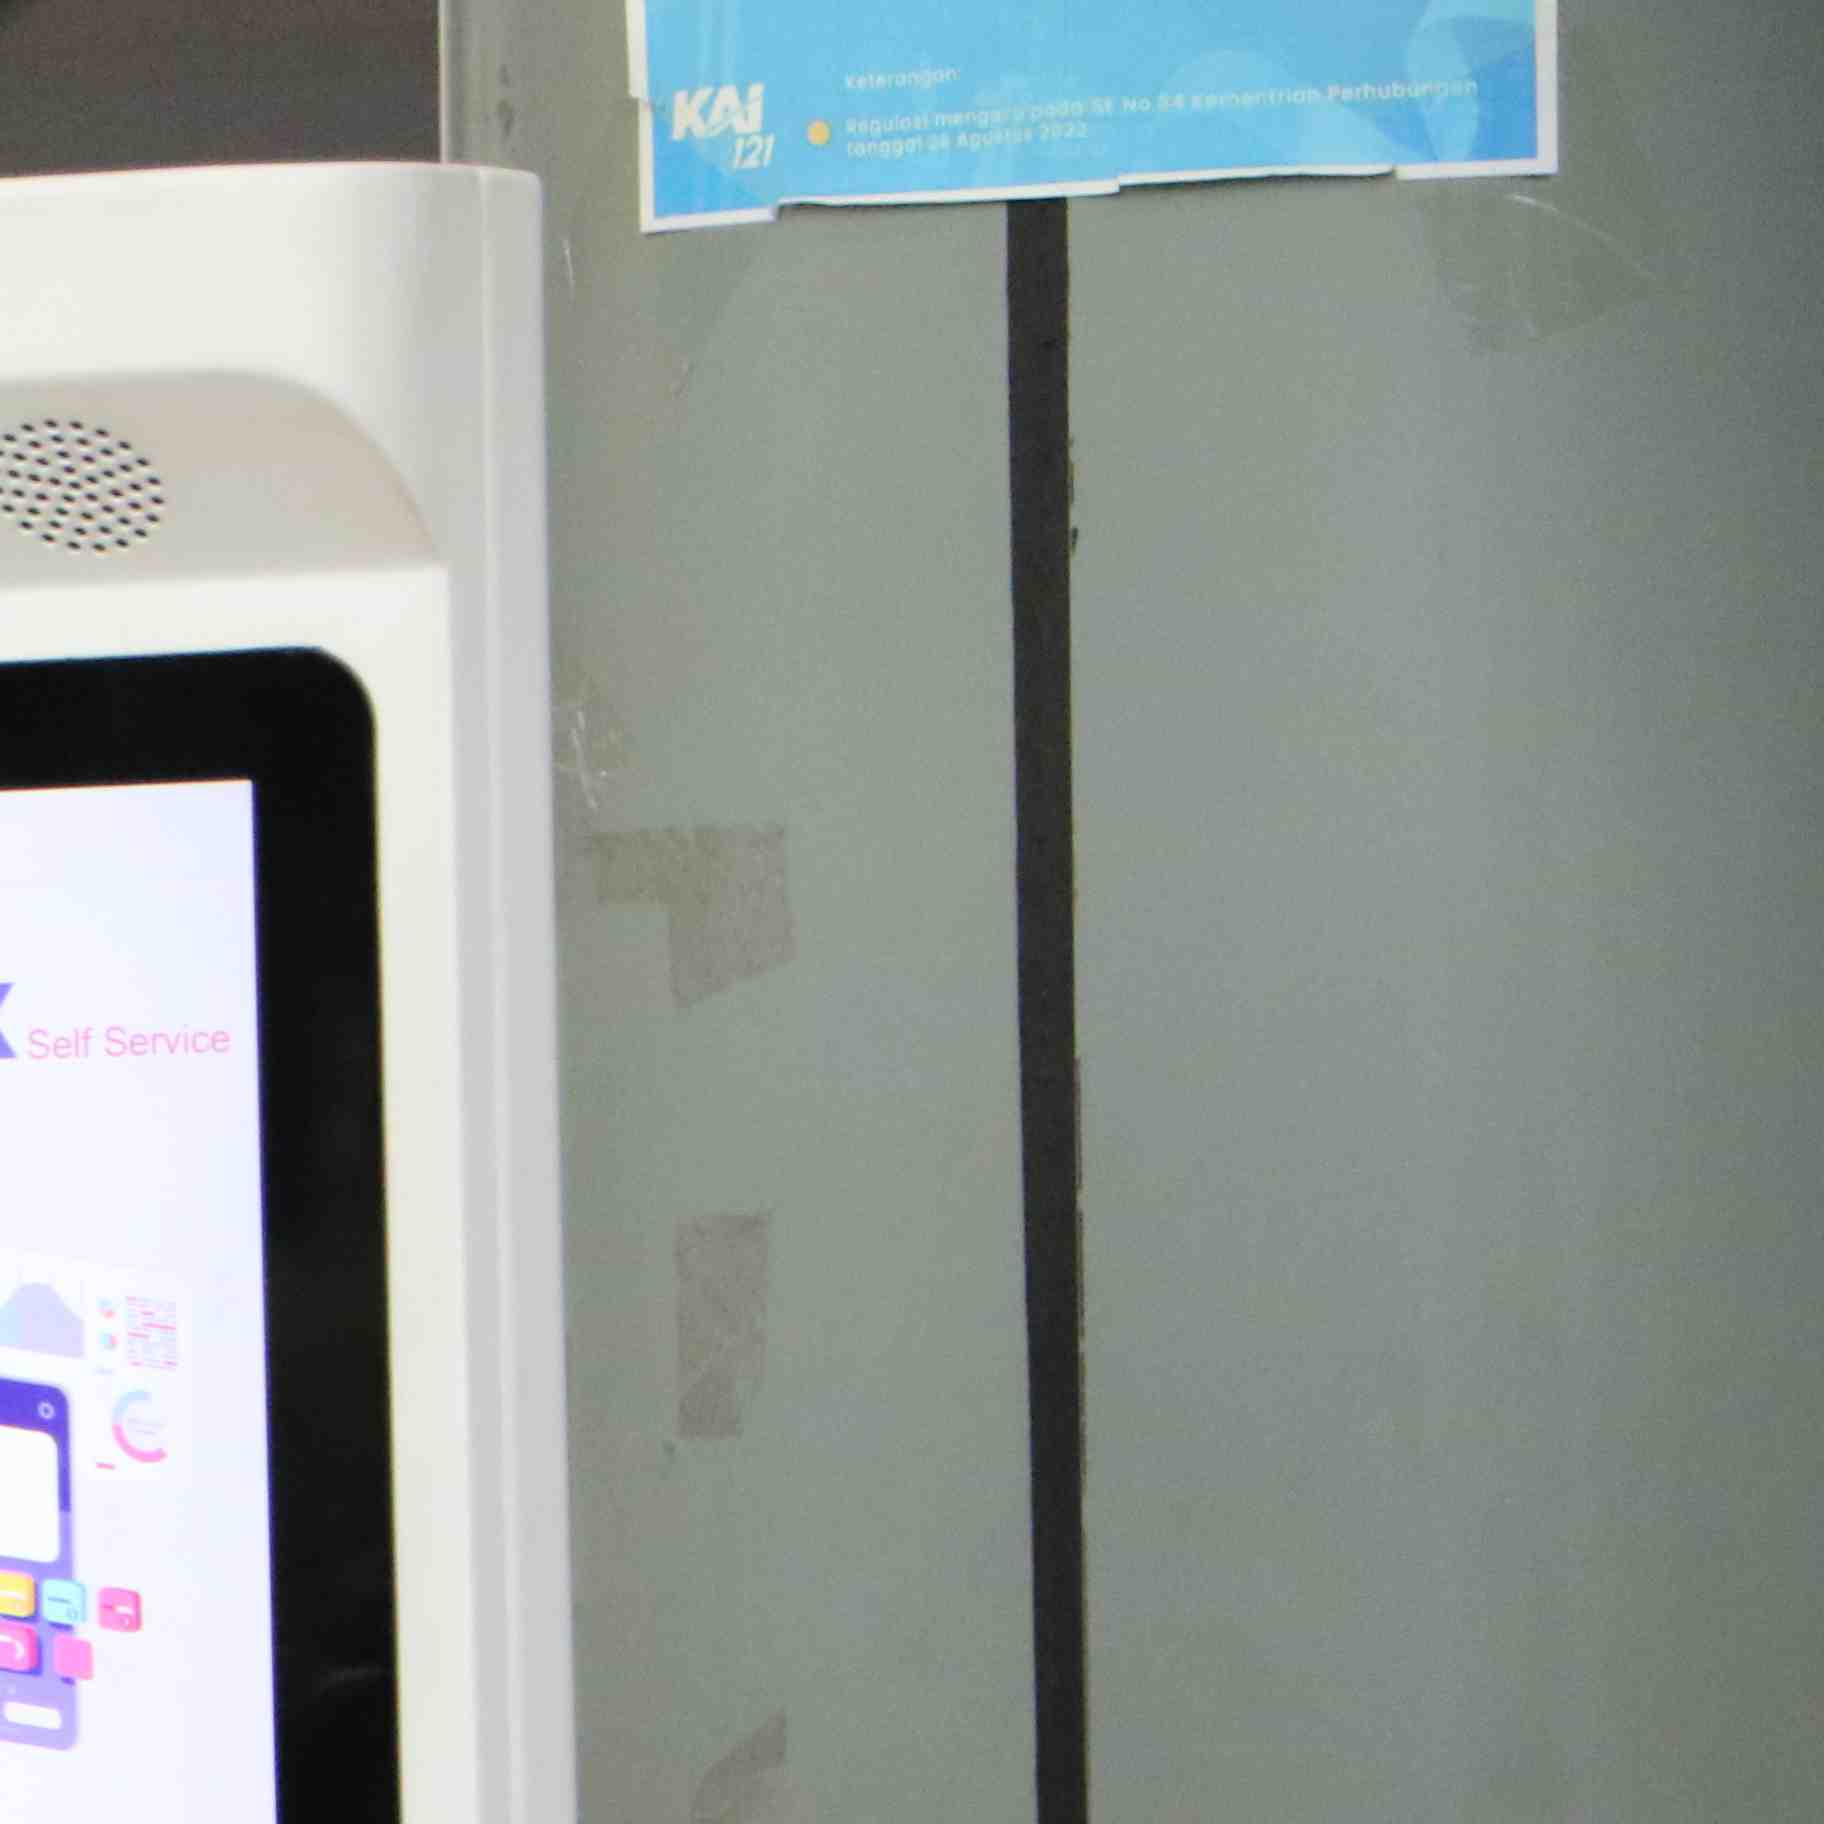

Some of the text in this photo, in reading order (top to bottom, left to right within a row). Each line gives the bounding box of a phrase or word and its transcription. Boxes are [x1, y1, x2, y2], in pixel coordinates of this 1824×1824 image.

[671, 82, 766, 141] KAI
[735, 132, 775, 168] 121
[28, 1027, 90, 1059] Self
[105, 1024, 229, 1055] Service
